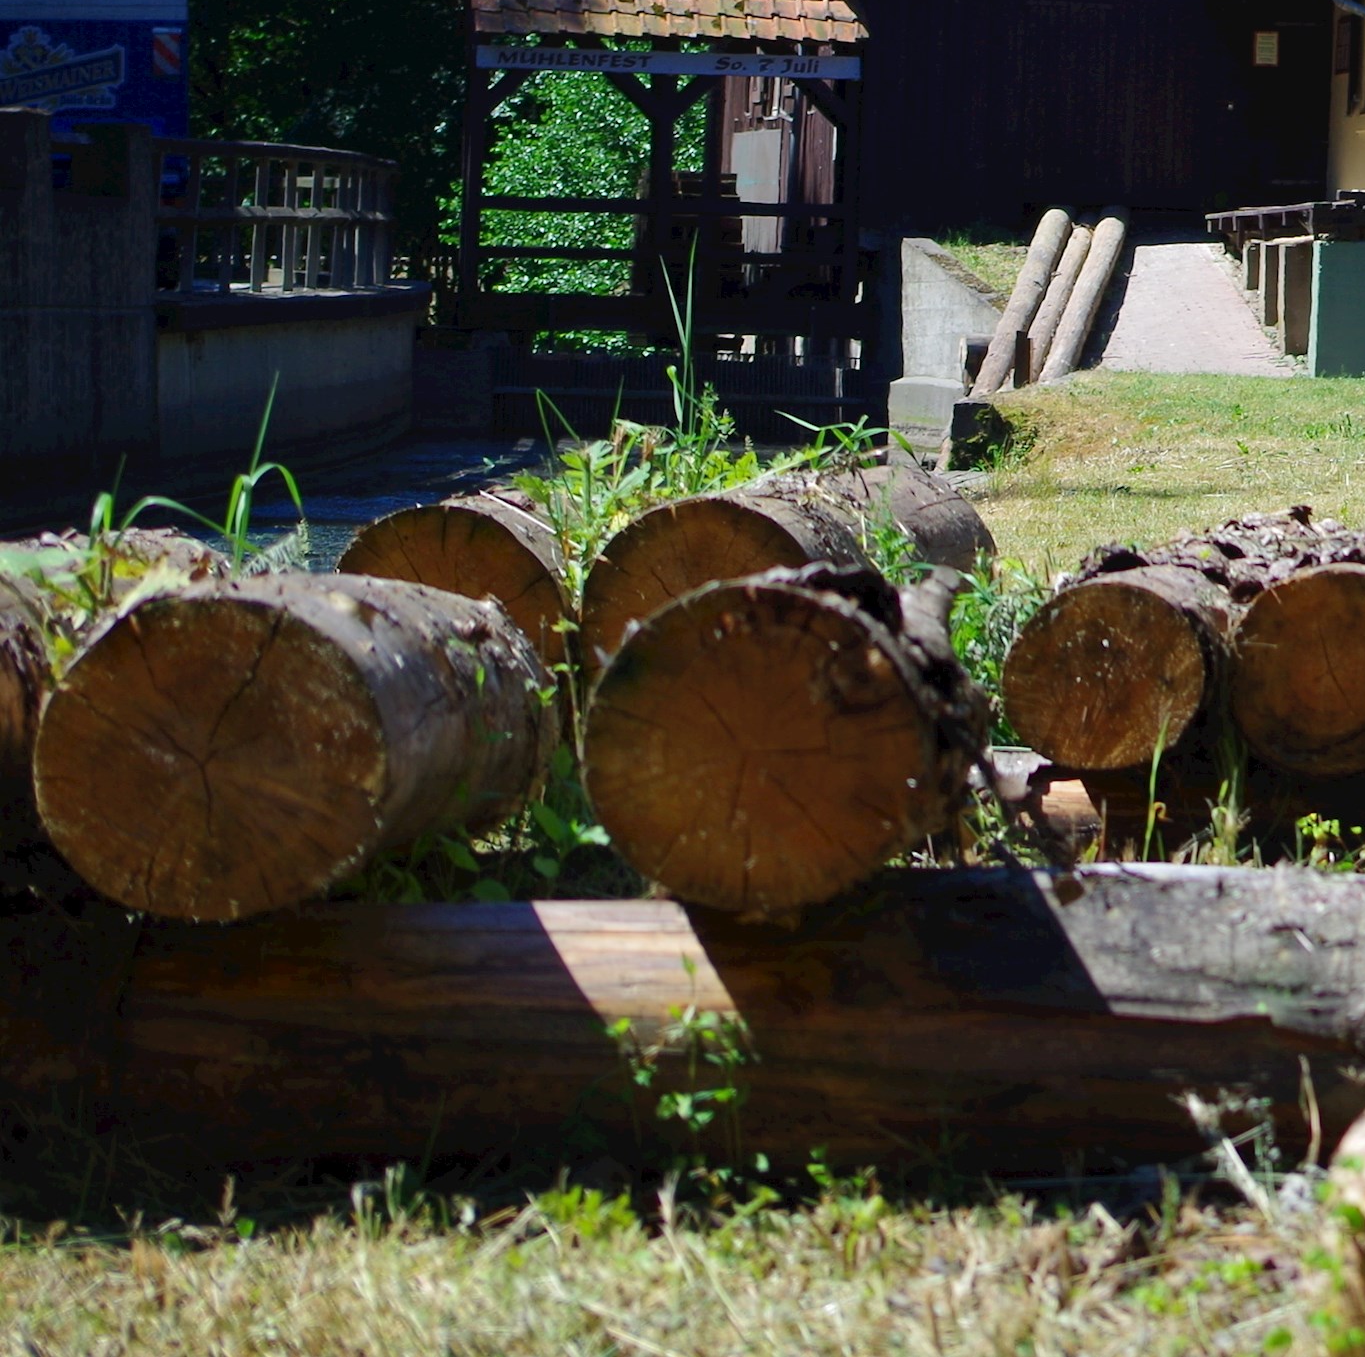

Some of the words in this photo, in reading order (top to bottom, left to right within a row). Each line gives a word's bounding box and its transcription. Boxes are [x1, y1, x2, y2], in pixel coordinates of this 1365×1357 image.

[497, 50, 654, 69] MÜHLENFEST
[714, 56, 746, 71] So.
[780, 58, 819, 74] Juli
